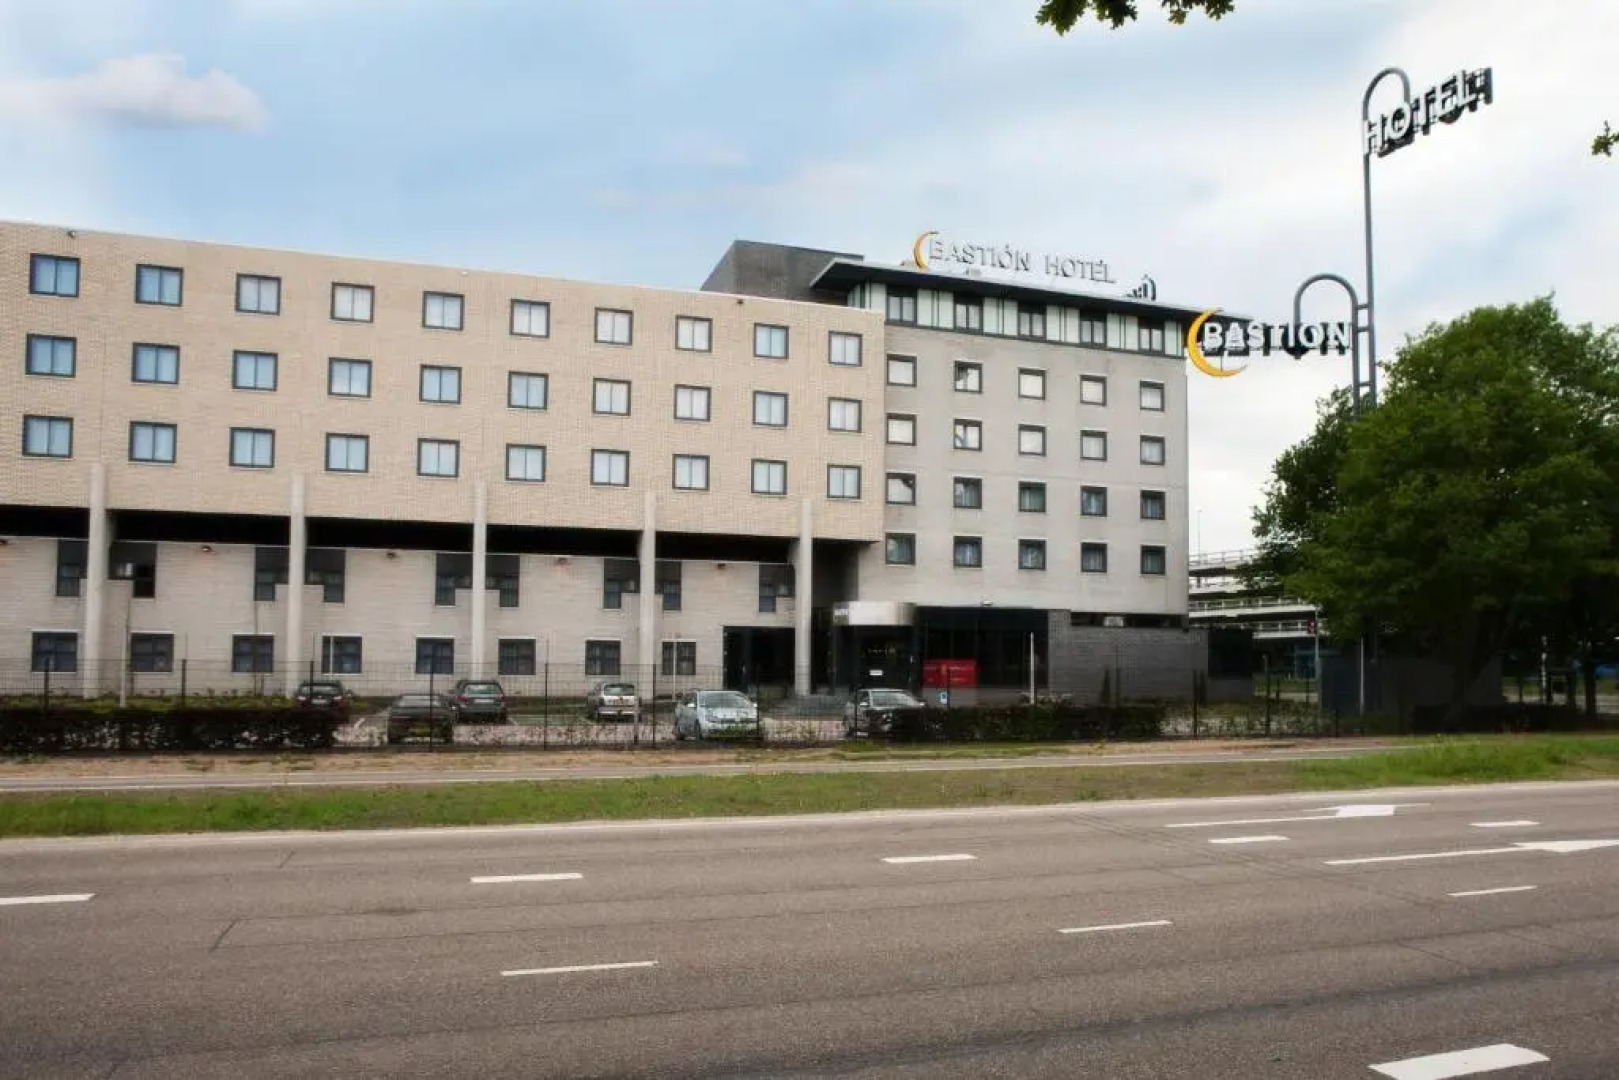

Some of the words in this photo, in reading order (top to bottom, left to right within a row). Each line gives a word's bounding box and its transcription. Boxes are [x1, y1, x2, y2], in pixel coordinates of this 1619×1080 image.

[1363, 69, 1485, 156] HOTEL
[1043, 253, 1116, 284] HOTEL
[1202, 318, 1351, 352] BASTION
